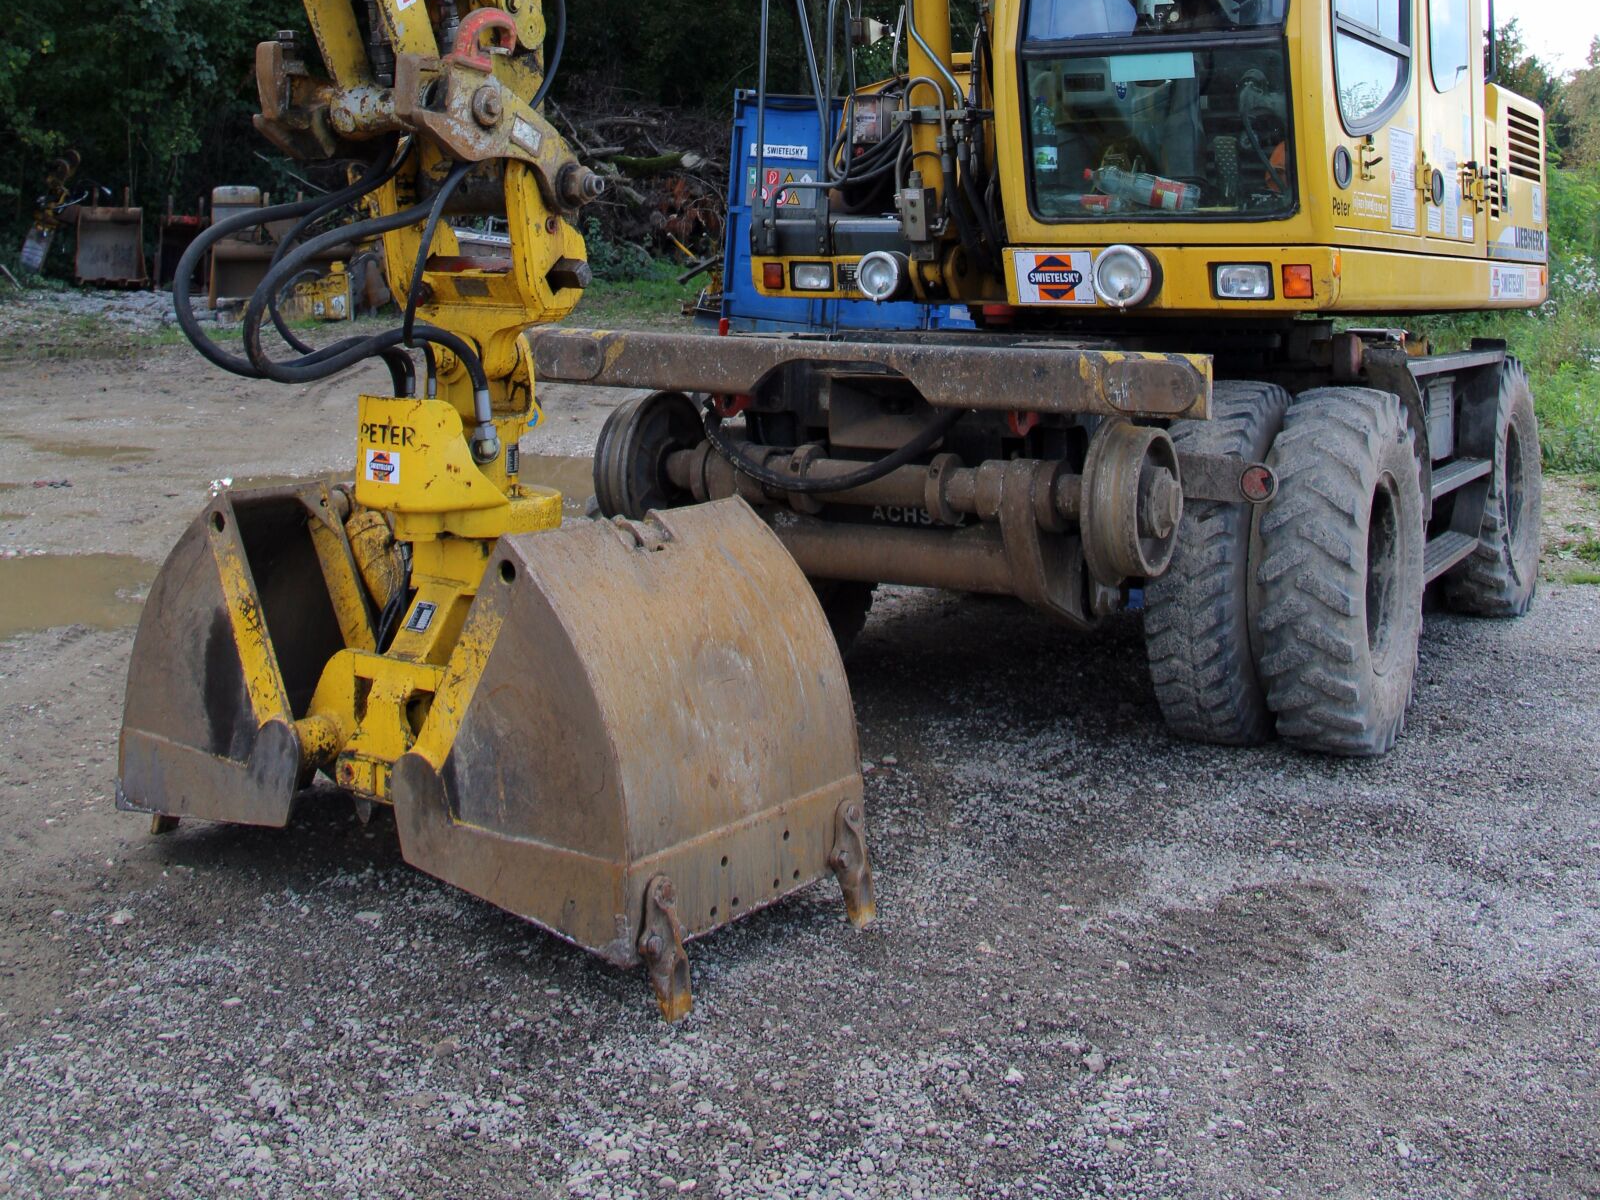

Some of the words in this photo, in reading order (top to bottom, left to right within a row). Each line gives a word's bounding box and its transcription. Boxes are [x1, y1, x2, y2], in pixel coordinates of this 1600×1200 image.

[767, 145, 804, 156] SWIETELSKY
[1332, 197, 1351, 217] Peter
[1514, 225, 1545, 252] LIEBHERR
[1030, 272, 1080, 283] SWIETELSKY
[360, 423, 416, 448] PETER
[872, 505, 944, 526] ACHS
